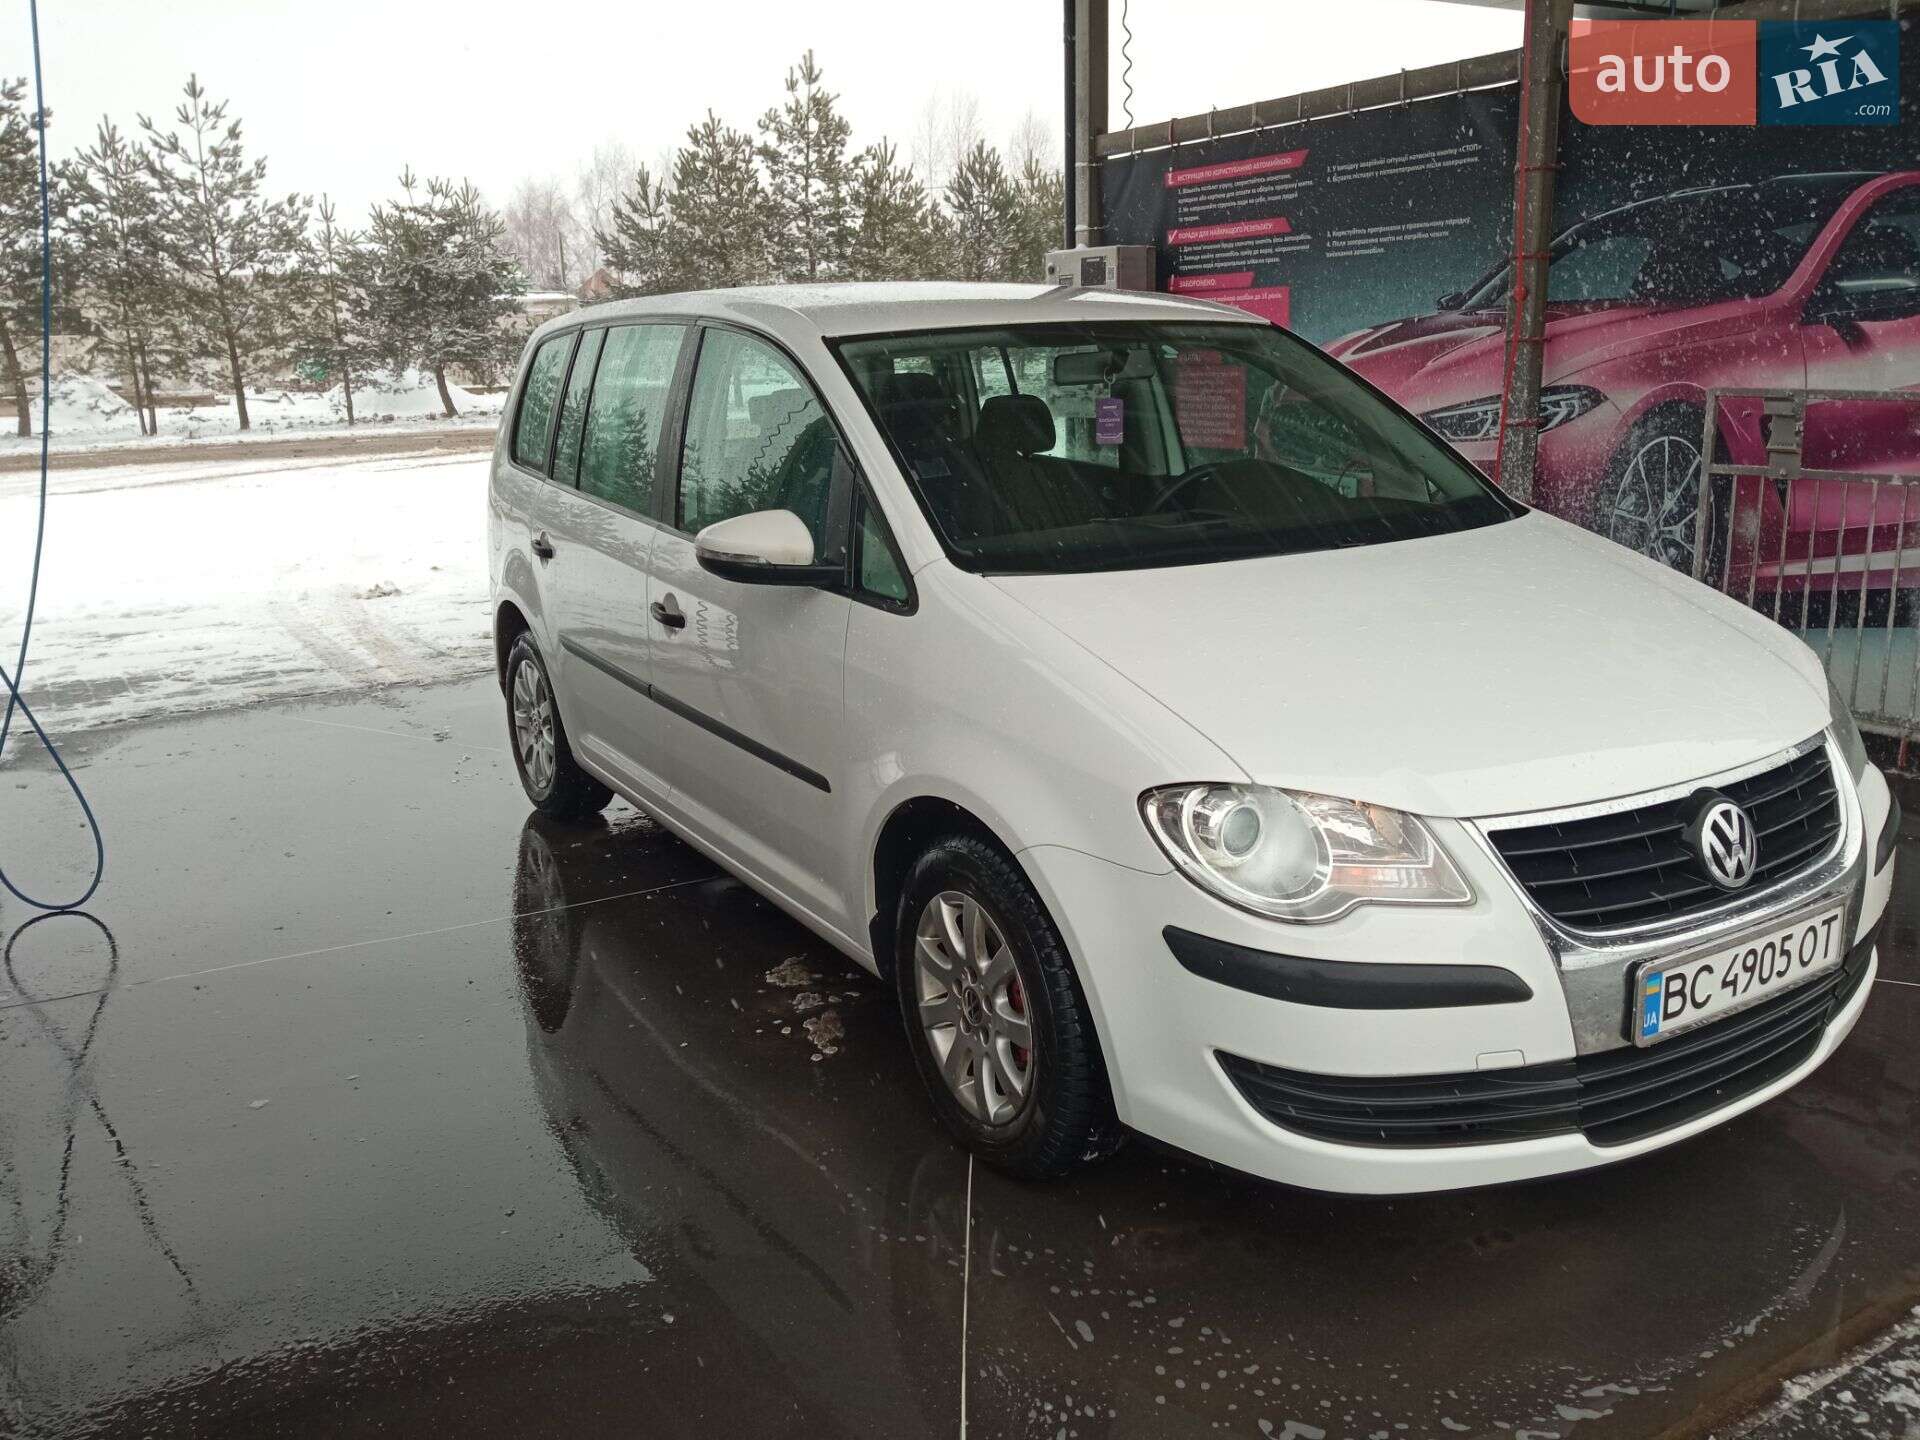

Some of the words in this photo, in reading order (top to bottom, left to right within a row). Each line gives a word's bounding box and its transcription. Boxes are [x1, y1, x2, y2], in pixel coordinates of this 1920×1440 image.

[1662, 964, 1714, 1022] BC
[1721, 933, 1793, 997] 4905
[1799, 914, 1839, 968] OT
[1643, 1012, 1657, 1028] UA
